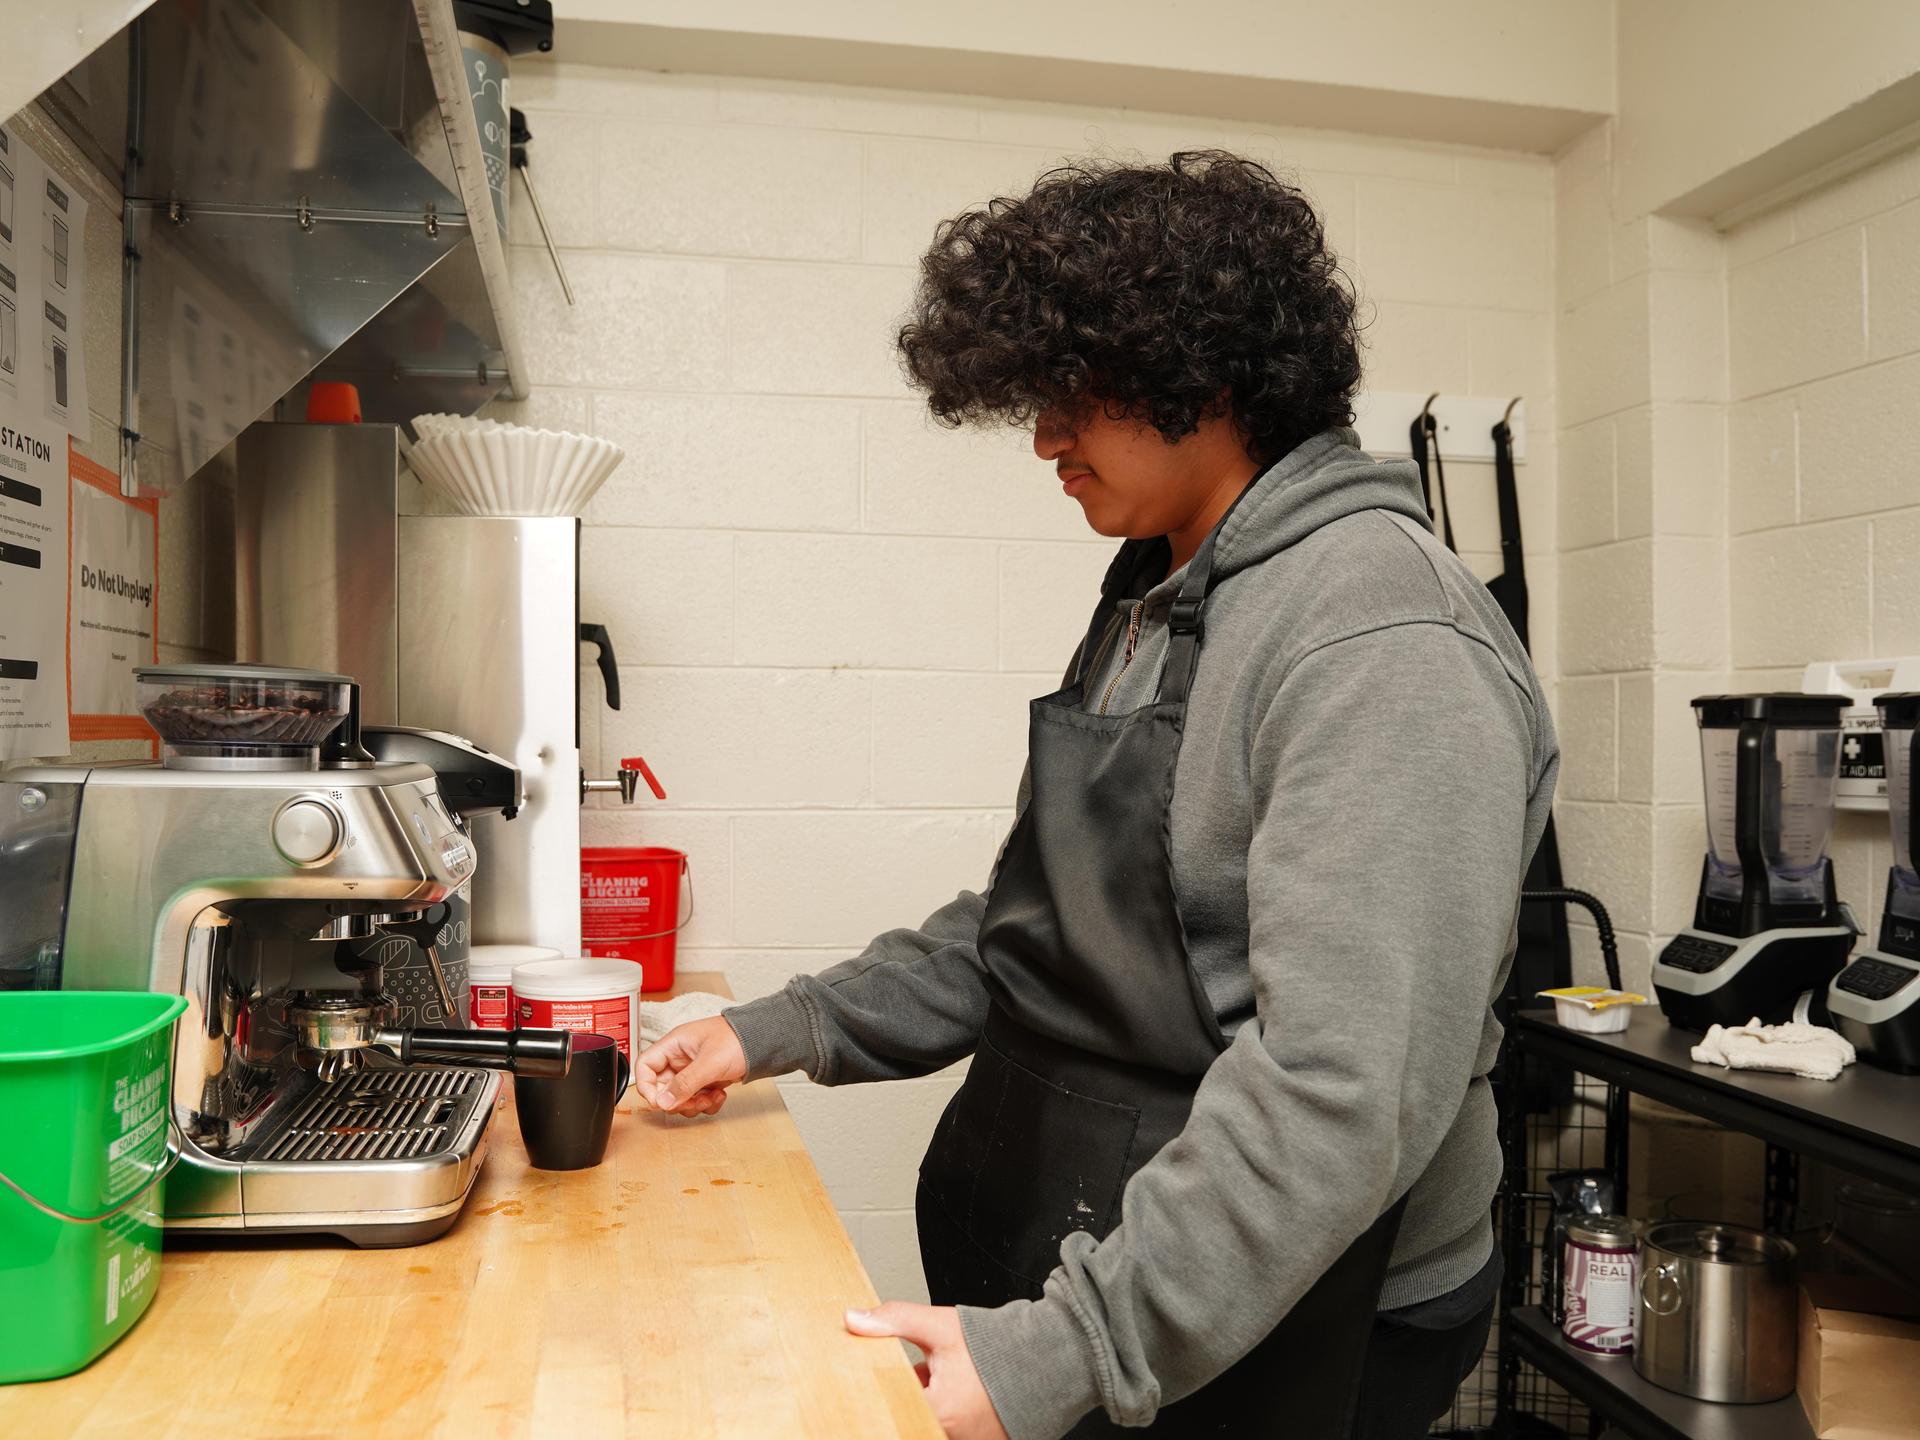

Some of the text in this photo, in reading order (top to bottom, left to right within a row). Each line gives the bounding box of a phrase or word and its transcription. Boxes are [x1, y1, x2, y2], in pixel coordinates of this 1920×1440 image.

[1, 426, 50, 463] STATION
[81, 564, 152, 608] Do Not Unplug!
[588, 887, 640, 898] BUCKET
[1590, 1264, 1629, 1276] REAL
